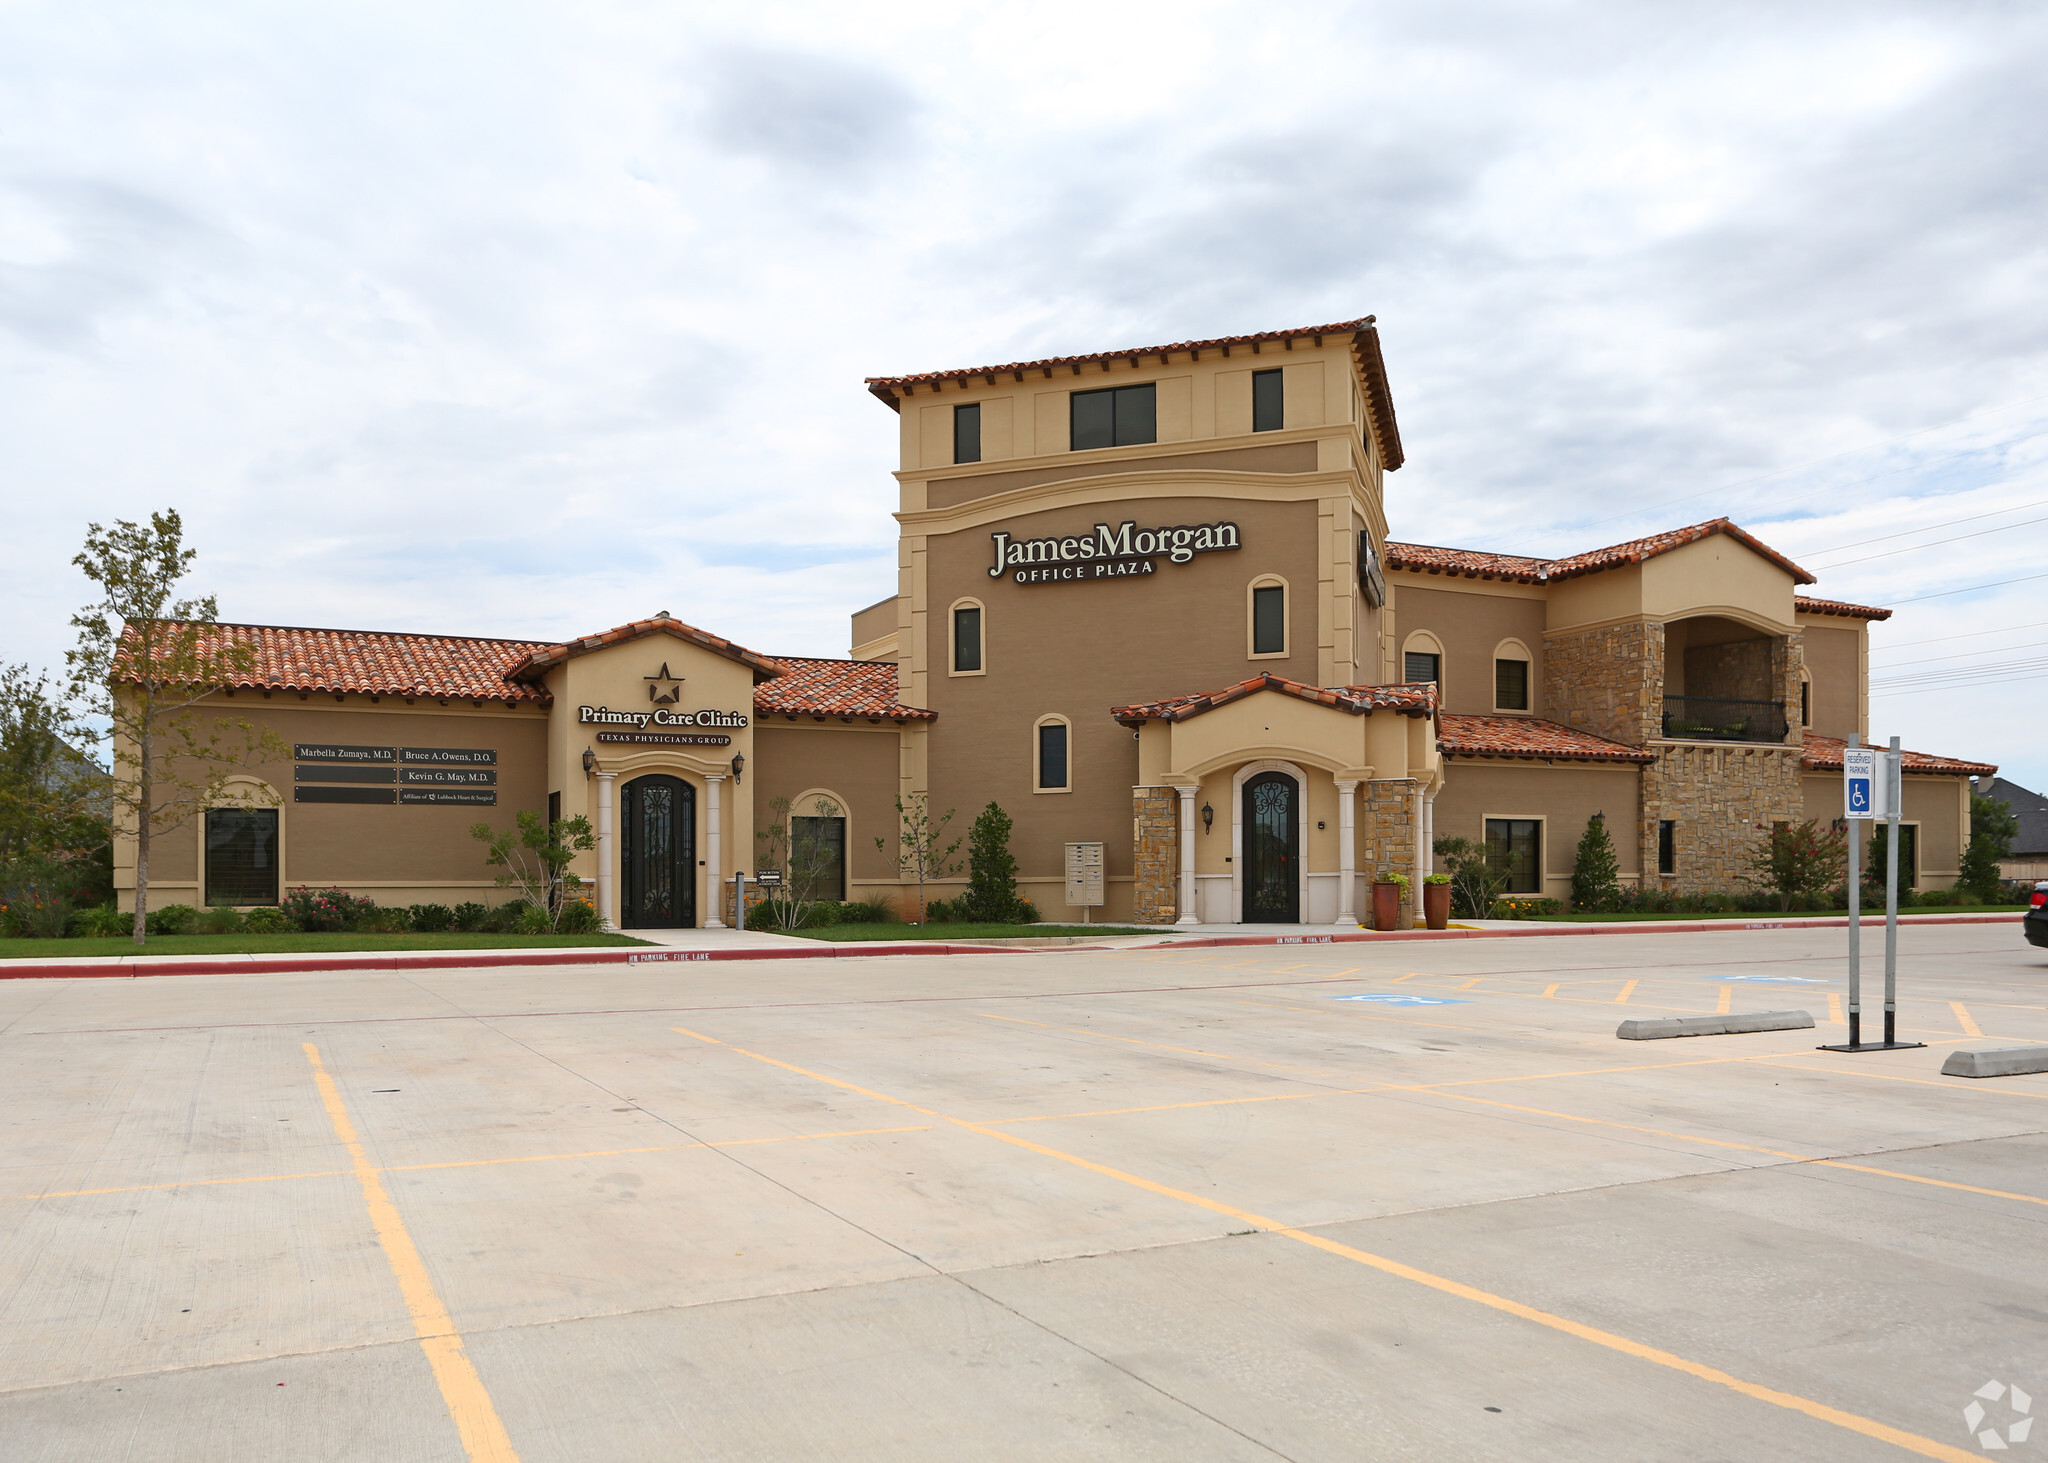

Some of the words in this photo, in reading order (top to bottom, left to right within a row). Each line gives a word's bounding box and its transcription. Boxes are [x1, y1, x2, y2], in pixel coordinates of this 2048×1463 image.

[989, 523, 1239, 577] JamesMorgan
[1016, 566, 1084, 583] OFFICE
[1095, 561, 1152, 577] PLAZA
[581, 707, 651, 729] Primary
[654, 709, 694, 725] Care
[696, 711, 748, 727] Clinic
[600, 734, 630, 742] TEXAS
[635, 735, 693, 743] PHYSICIANS
[300, 748, 336, 757] Marbella
[338, 749, 371, 760] Zumaya,
[373, 750, 392, 759] M.D.
[405, 751, 429, 760] Bruce
[473, 753, 491, 761] D.O.
[1847, 755, 1871, 764] RESERVED
[1849, 766, 1869, 774] PARKING
[408, 772, 433, 780] Kevin
[435, 772, 445, 781] G.
[447, 773, 466, 783] May,
[468, 773, 488, 782] M.D.
[640, 953, 668, 962] PARKING
[673, 953, 690, 961] FIRE
[692, 952, 710, 961] LANE
